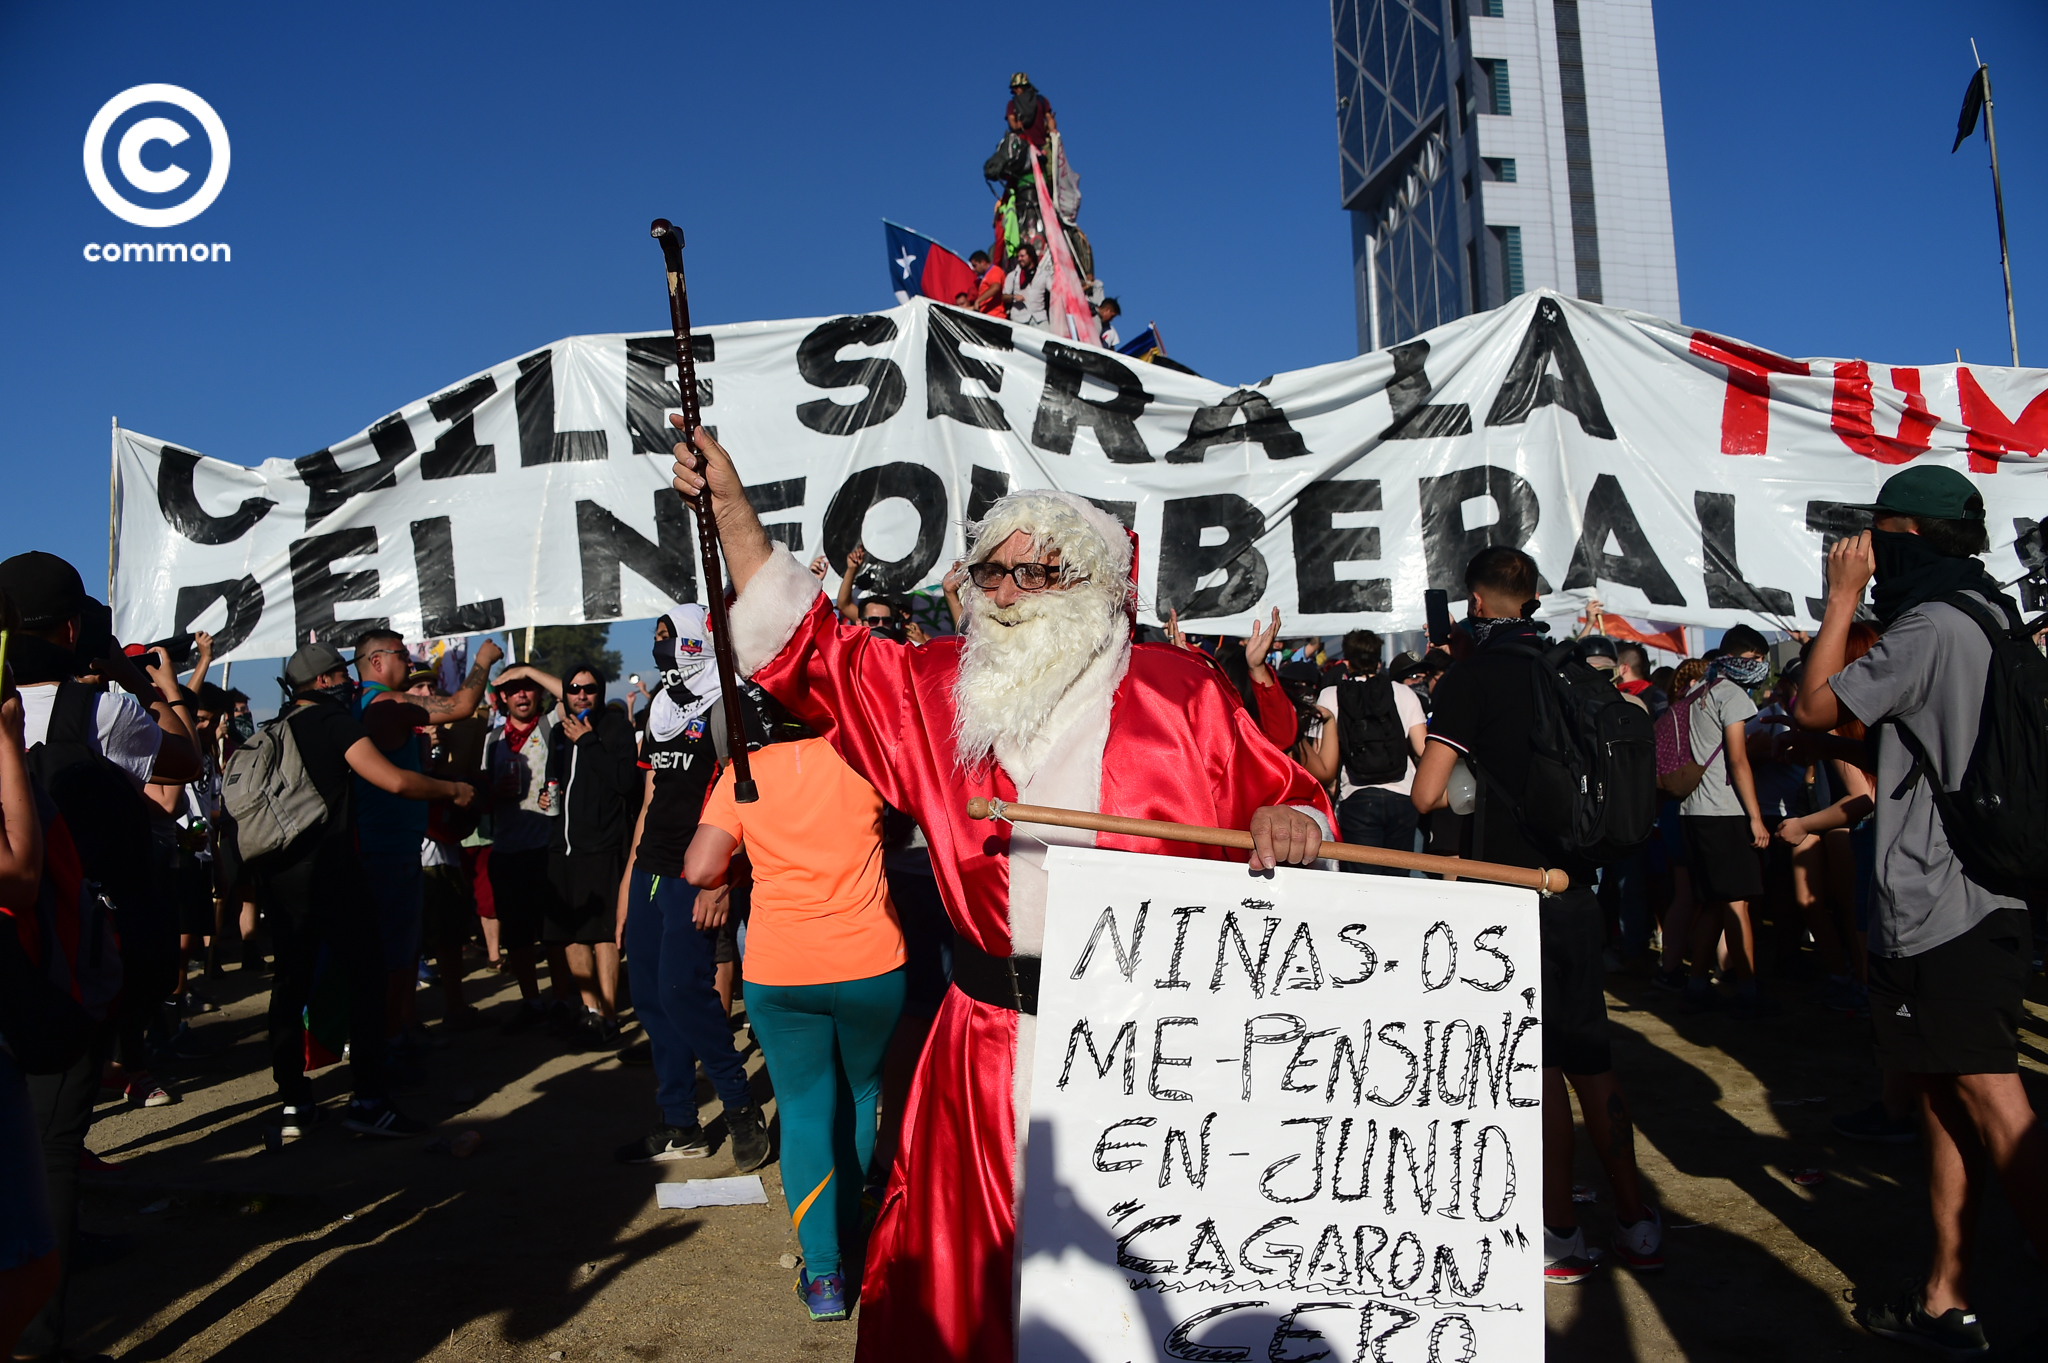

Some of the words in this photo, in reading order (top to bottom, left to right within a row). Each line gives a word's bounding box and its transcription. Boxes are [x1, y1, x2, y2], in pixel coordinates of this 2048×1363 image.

[157, 334, 714, 546] CHILE
[1378, 296, 1617, 441] LA
[173, 515, 505, 673] DEL
